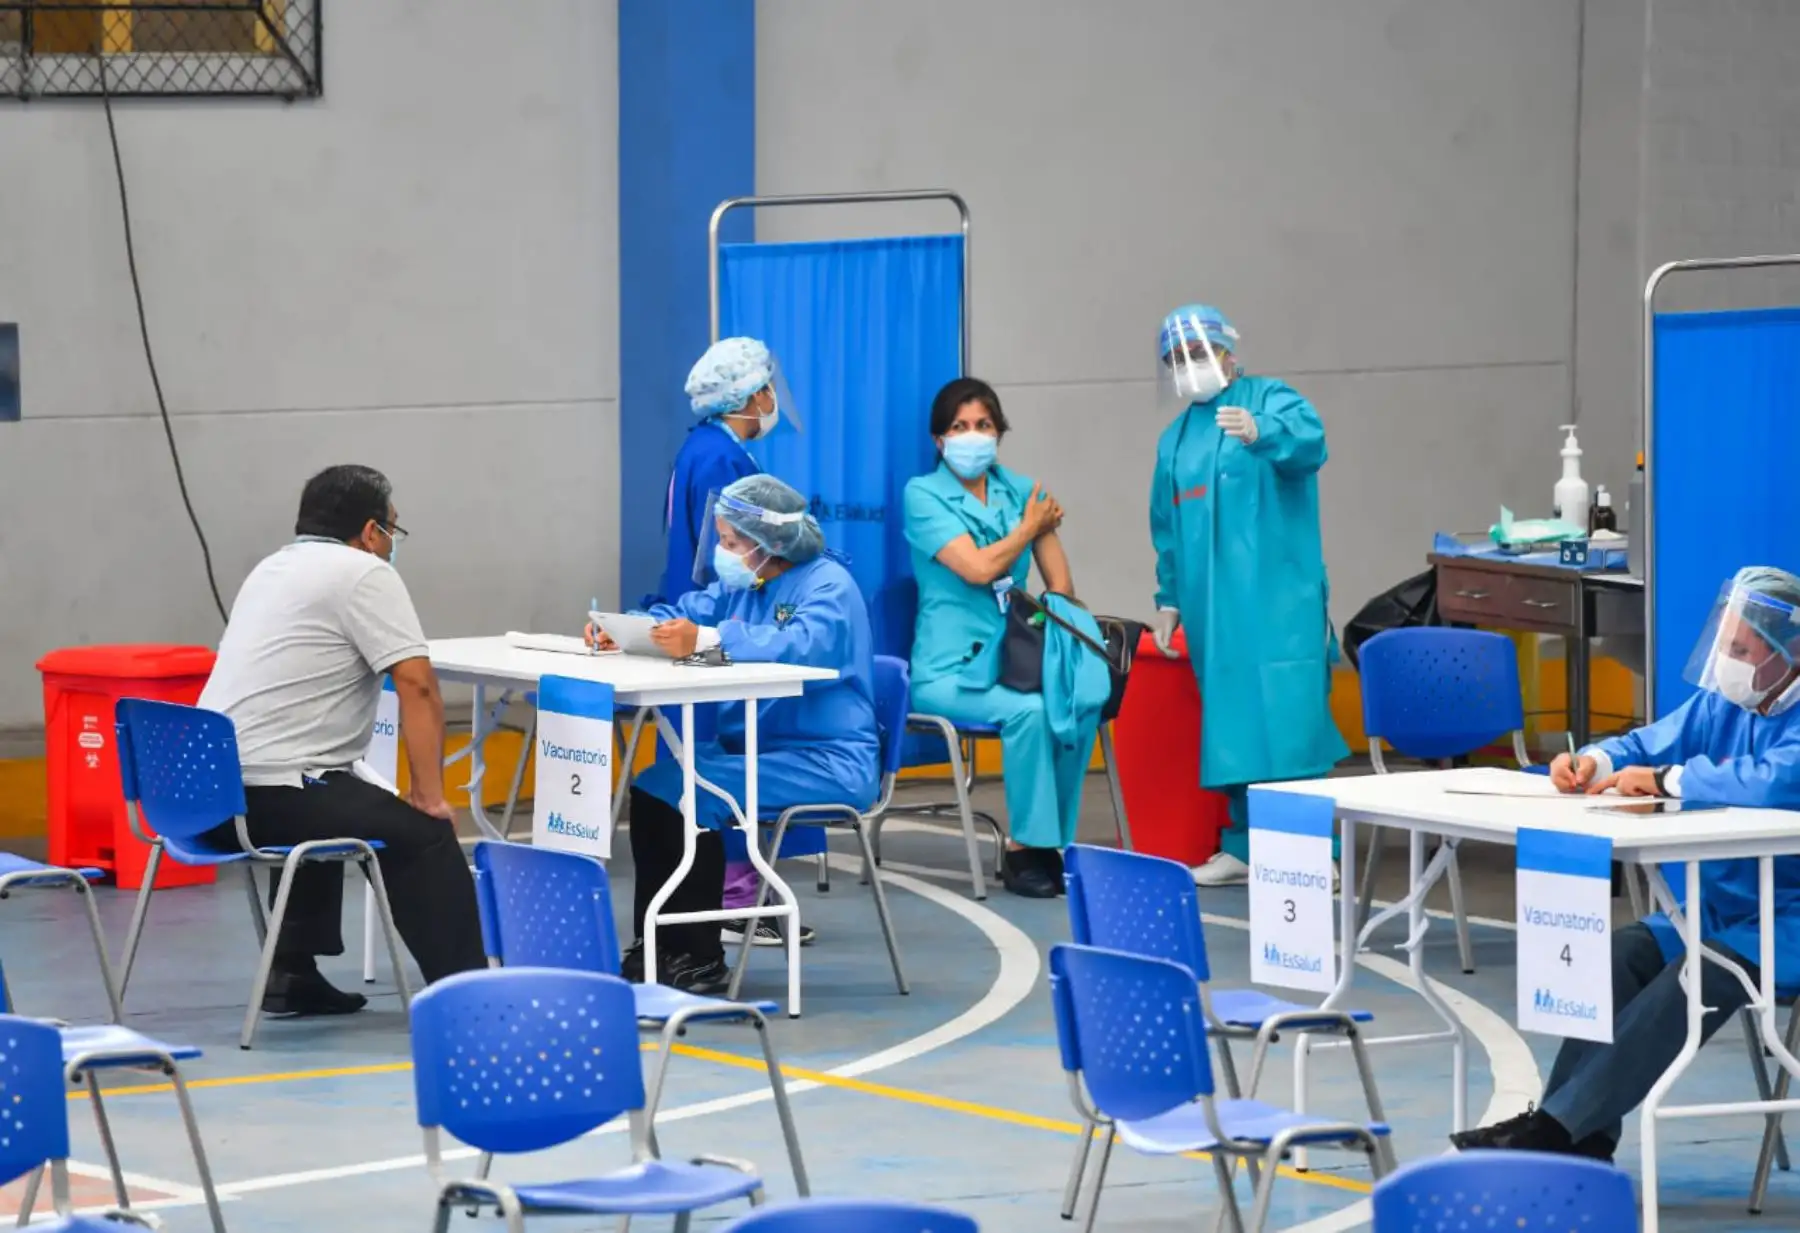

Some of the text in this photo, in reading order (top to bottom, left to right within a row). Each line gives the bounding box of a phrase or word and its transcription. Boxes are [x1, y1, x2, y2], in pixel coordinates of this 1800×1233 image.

[541, 739, 608, 766] Vacunatorio
[570, 773, 582, 795] 2
[565, 820, 600, 841] EsSalud
[1254, 863, 1327, 891] Vacunatorio
[1283, 899, 1297, 923] 3
[1523, 905, 1605, 934] Vacunatorio
[1282, 951, 1322, 973] EsSalud
[1559, 943, 1573, 967] 4
[1556, 995, 1598, 1021] EsSalud
